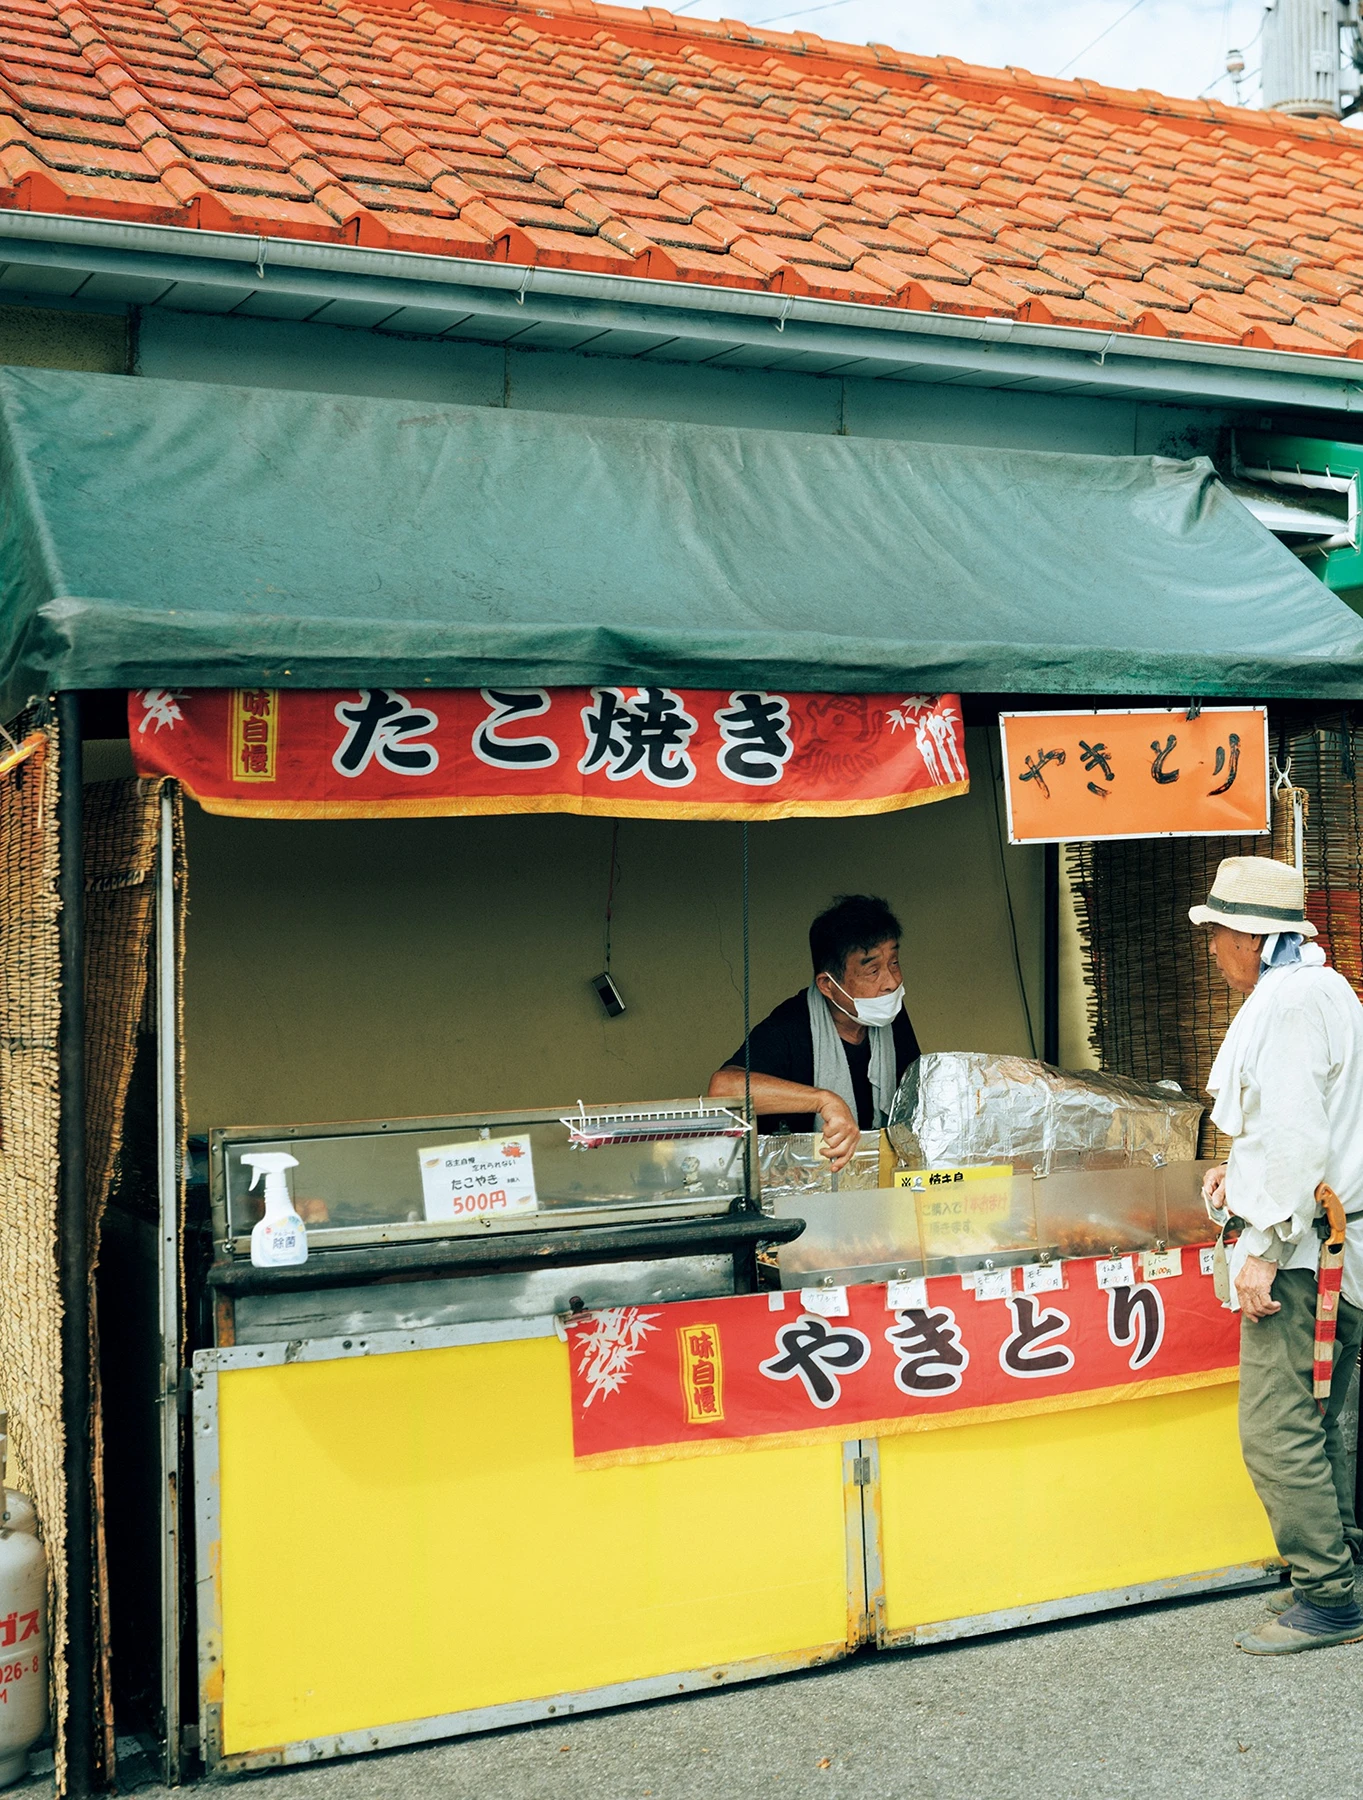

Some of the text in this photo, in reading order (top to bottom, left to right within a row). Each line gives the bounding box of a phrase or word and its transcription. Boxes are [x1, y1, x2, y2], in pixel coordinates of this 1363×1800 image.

[241, 689, 272, 774] 味自慢
[334, 687, 794, 788] たこ焼き
[1019, 733, 1241, 799] やきとり
[451, 1174, 498, 1191] たこやき
[453, 1189, 507, 1214] 500円
[272, 1236, 296, 1250] 除菌
[1148, 1256, 1168, 1266] レバー
[689, 1330, 717, 1415] 味自慢
[758, 1283, 1164, 1409] やきとり
